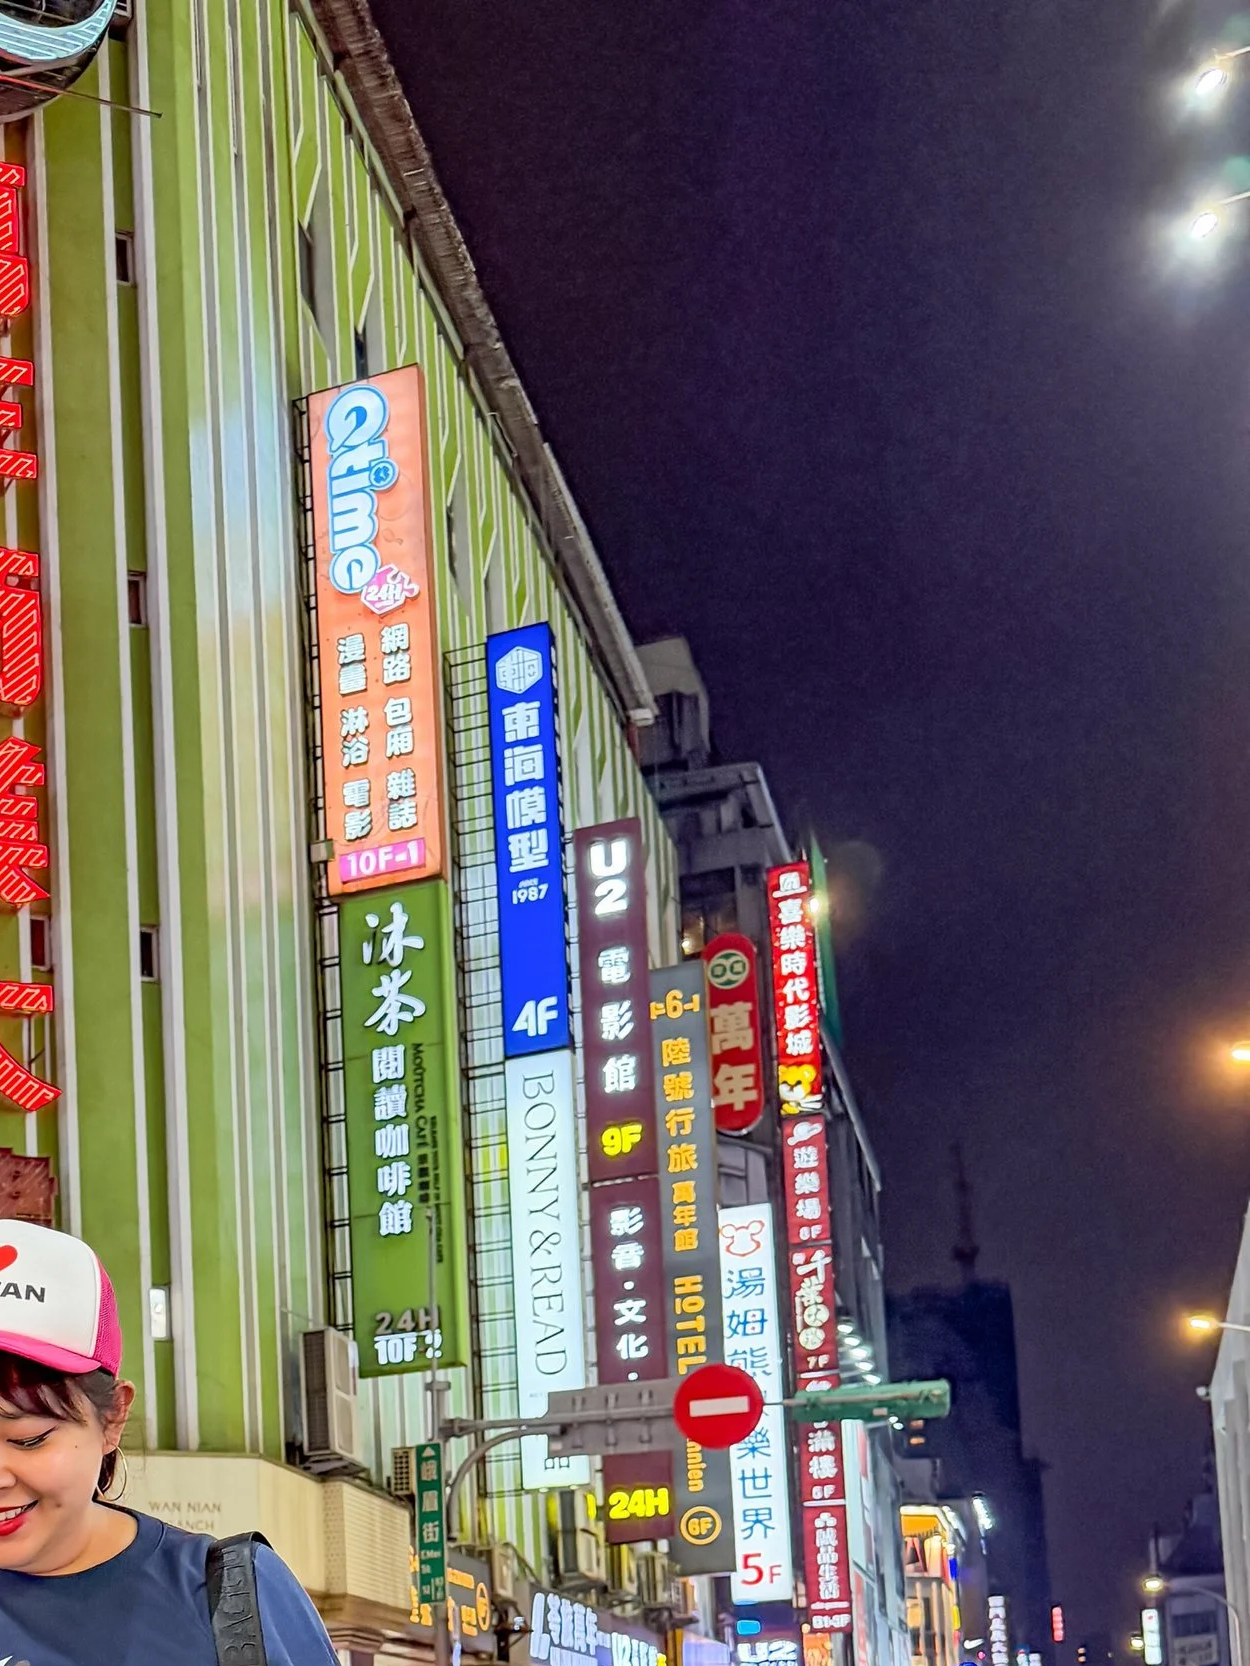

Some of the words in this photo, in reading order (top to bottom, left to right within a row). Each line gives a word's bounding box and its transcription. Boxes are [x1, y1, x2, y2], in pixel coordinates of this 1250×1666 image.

[337, 632, 367, 695] 漫畫
[380, 622, 411, 685] 網路
[340, 706, 369, 767] 淋浴
[383, 697, 414, 757] 包廂
[342, 778, 373, 841] 電影
[386, 767, 417, 831] 雜誌
[347, 840, 420, 878] 10F-1
[512, 883, 549, 905] 1987
[512, 996, 558, 1037] 4F
[597, 946, 637, 1094] 電影館
[709, 1001, 758, 1112] 萬年
[661, 1037, 699, 1173] 陸號行旅
[372, 1044, 413, 1236] 閱讀咖啡館
[522, 1069, 560, 1221] BONNY
[601, 1124, 643, 1157] 9F
[528, 1229, 562, 1257] &
[531, 1264, 568, 1376] READ
[673, 1274, 708, 1376] HOTEL
[724, 1267, 775, 1540] 湯姆熊樂世界
[608, 1487, 670, 1520] 24H
[741, 1552, 782, 1586] 5F
